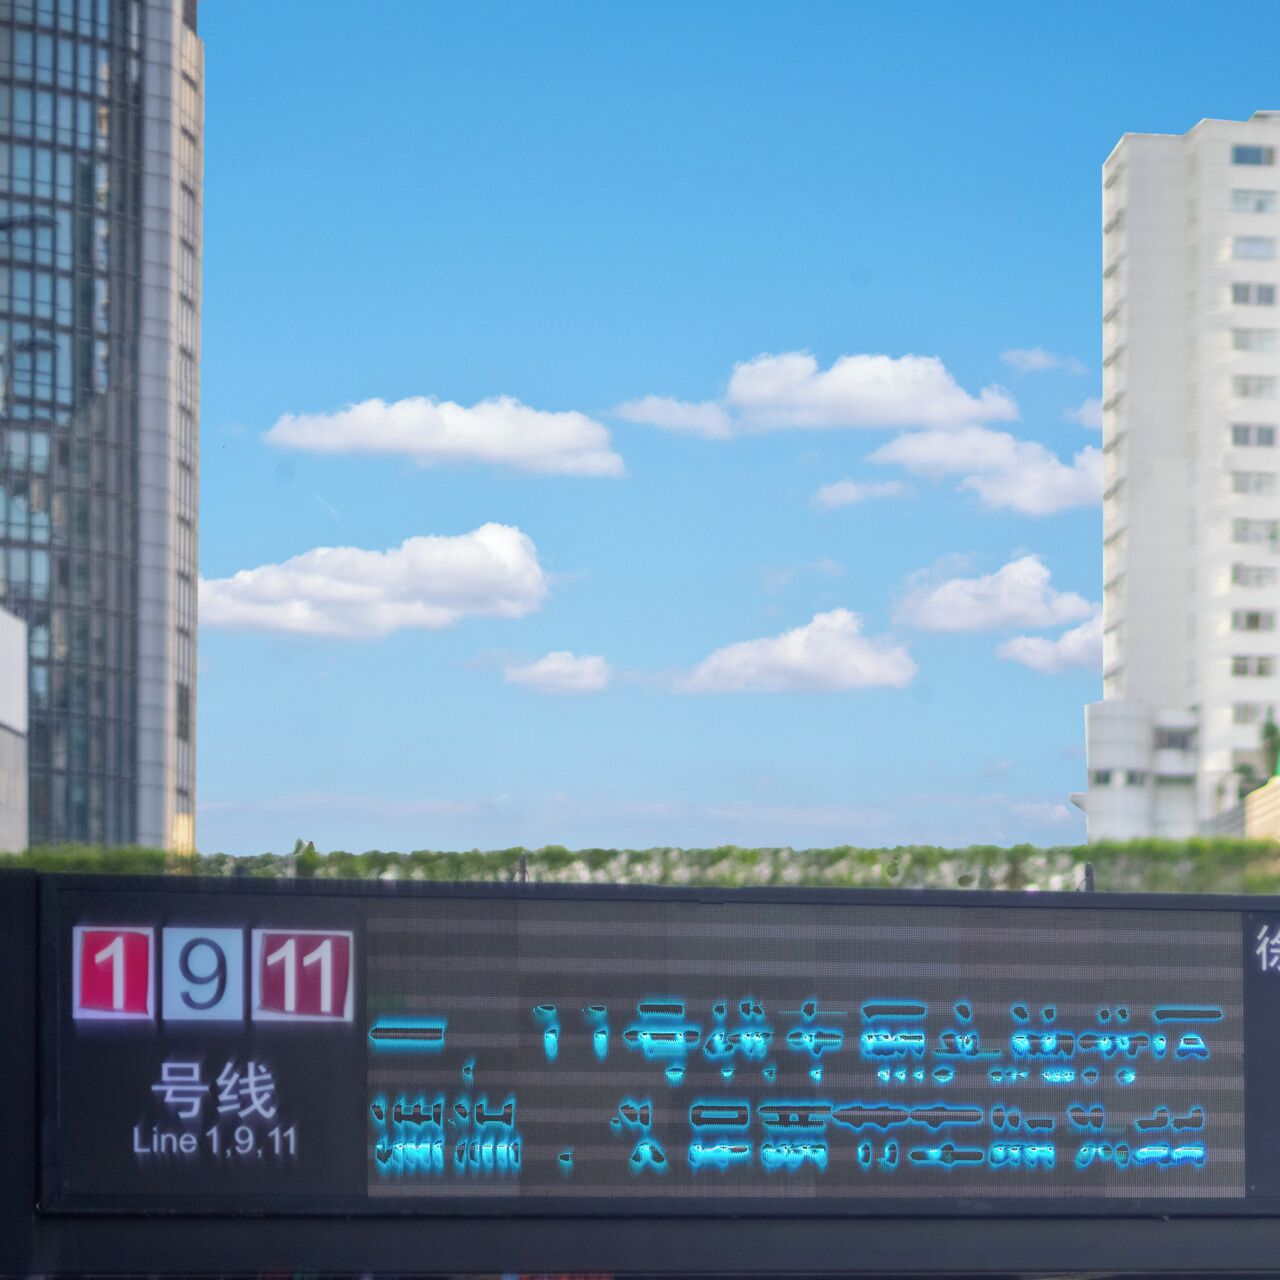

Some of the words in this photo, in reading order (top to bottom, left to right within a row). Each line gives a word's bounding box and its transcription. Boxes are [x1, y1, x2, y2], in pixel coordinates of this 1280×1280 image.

[94, 936, 126, 1011] 1
[178, 936, 228, 1010] 9
[264, 938, 336, 1015] 11
[151, 1062, 276, 1120] 号线
[133, 1126, 198, 1154] Line
